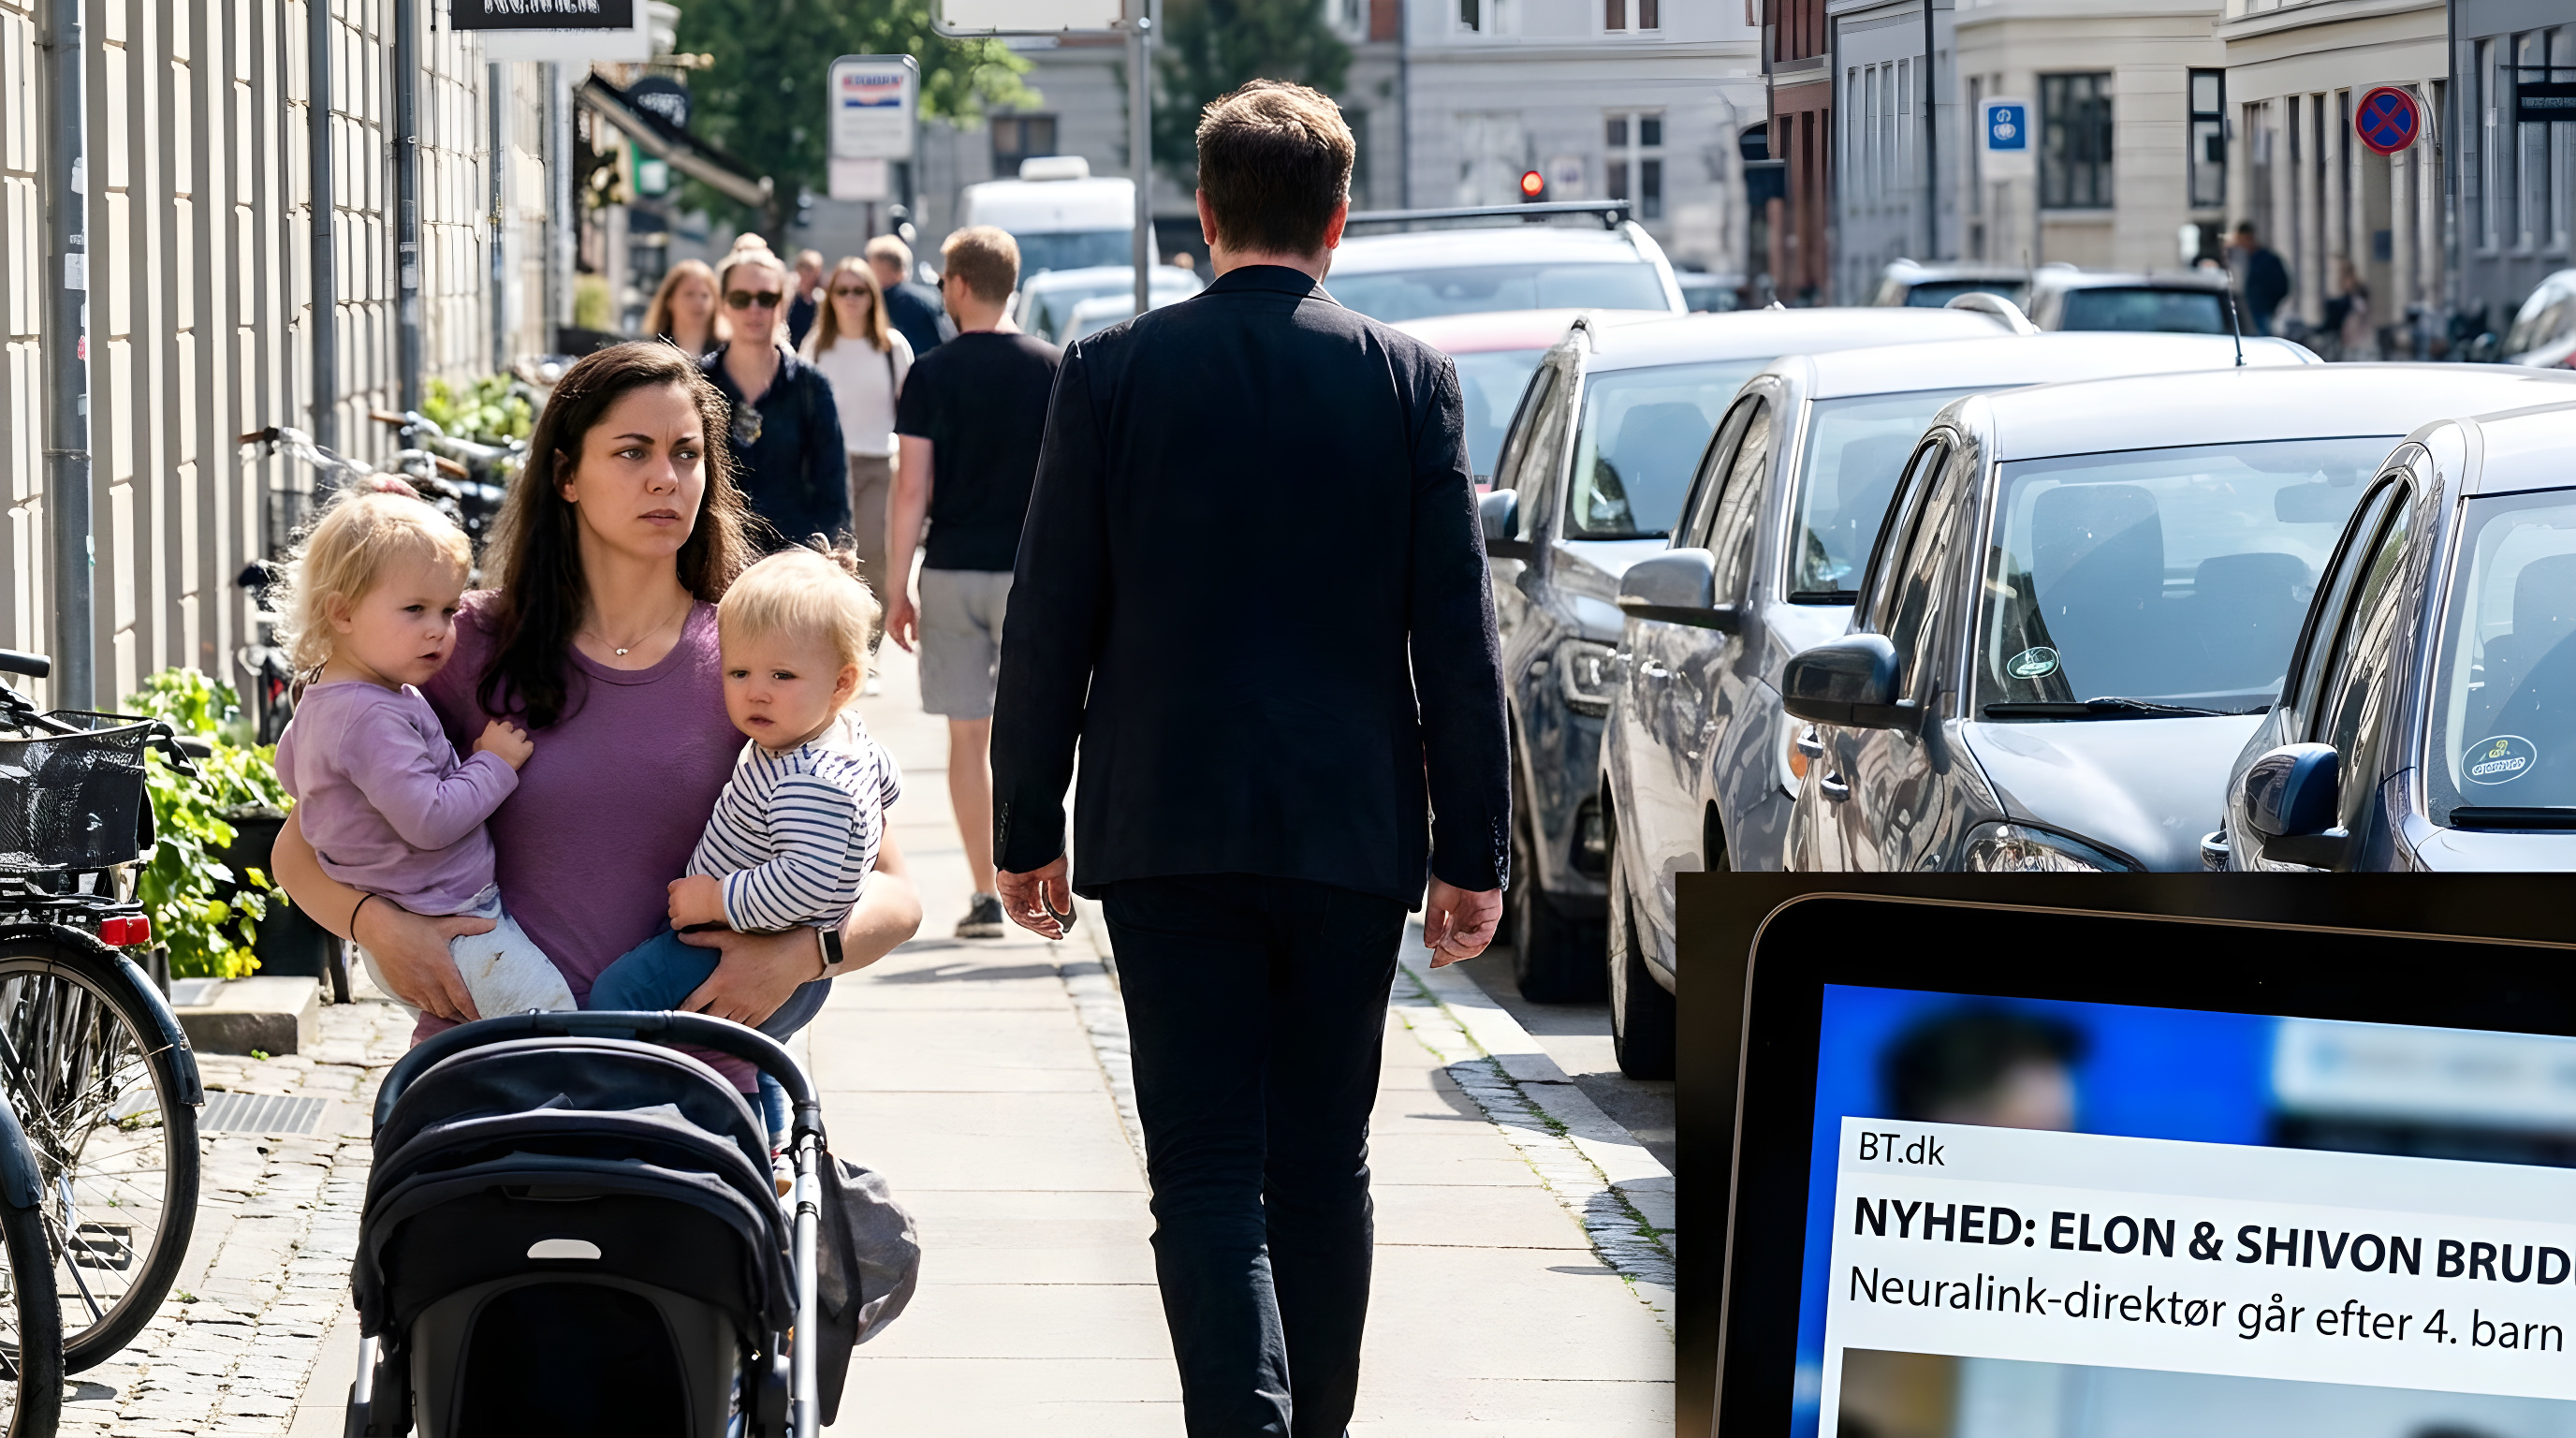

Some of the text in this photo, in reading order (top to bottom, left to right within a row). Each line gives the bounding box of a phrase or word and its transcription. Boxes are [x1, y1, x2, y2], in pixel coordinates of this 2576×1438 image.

[1859, 1131, 1945, 1167] BT.dk
[1854, 1196, 2576, 1286] NYHED: ELON & SHIVON BRUD
[1850, 1266, 2563, 1353] Neuralink-direktør går efter 4. barn
